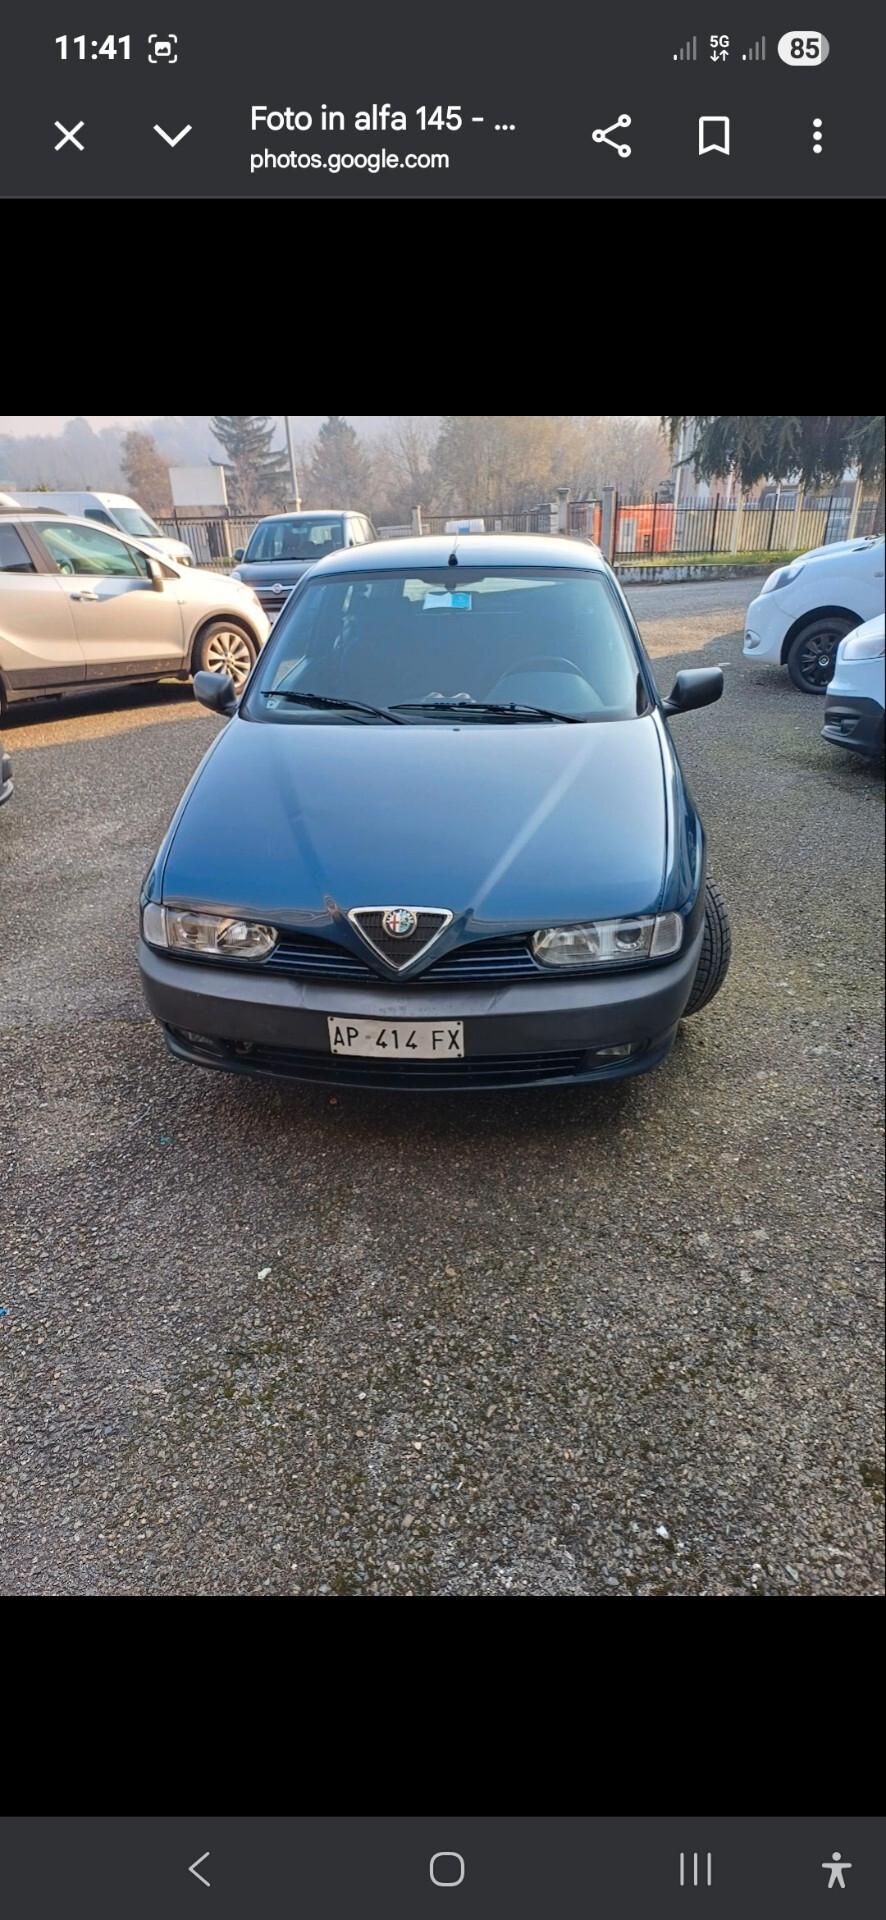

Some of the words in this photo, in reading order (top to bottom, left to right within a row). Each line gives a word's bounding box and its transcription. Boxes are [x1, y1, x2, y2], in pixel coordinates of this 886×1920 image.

[333, 1025, 359, 1047] AP
[375, 1028, 418, 1050] 414
[431, 1029, 461, 1051] FX
